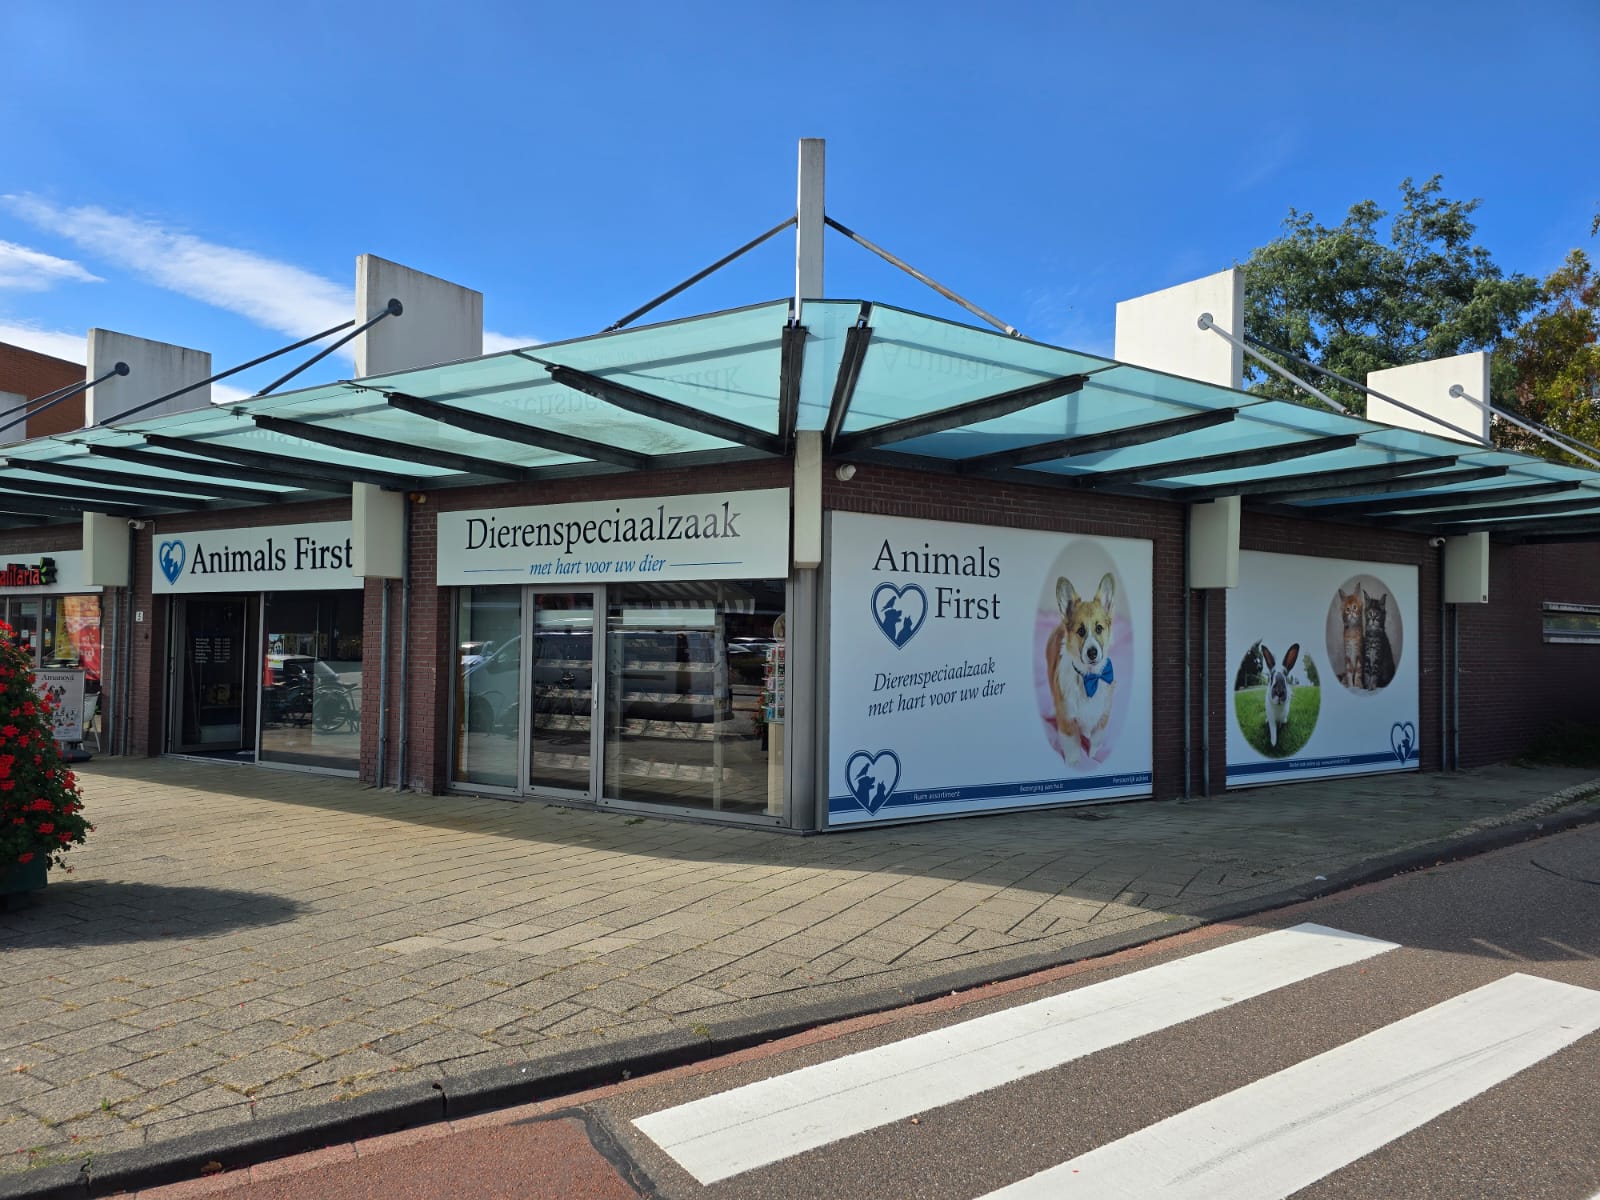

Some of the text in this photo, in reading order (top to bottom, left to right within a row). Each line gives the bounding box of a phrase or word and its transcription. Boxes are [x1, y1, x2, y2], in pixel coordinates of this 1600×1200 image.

[465, 501, 741, 554] Dierenspeciaalzaak
[190, 536, 353, 574] Animals First
[529, 554, 667, 576] met hart voor uw dier
[872, 538, 1000, 578] Animals
[934, 586, 1001, 620] First
[872, 656, 996, 692] Dierenspeciaalzaak
[868, 679, 1006, 717] met hart voor uw dier
